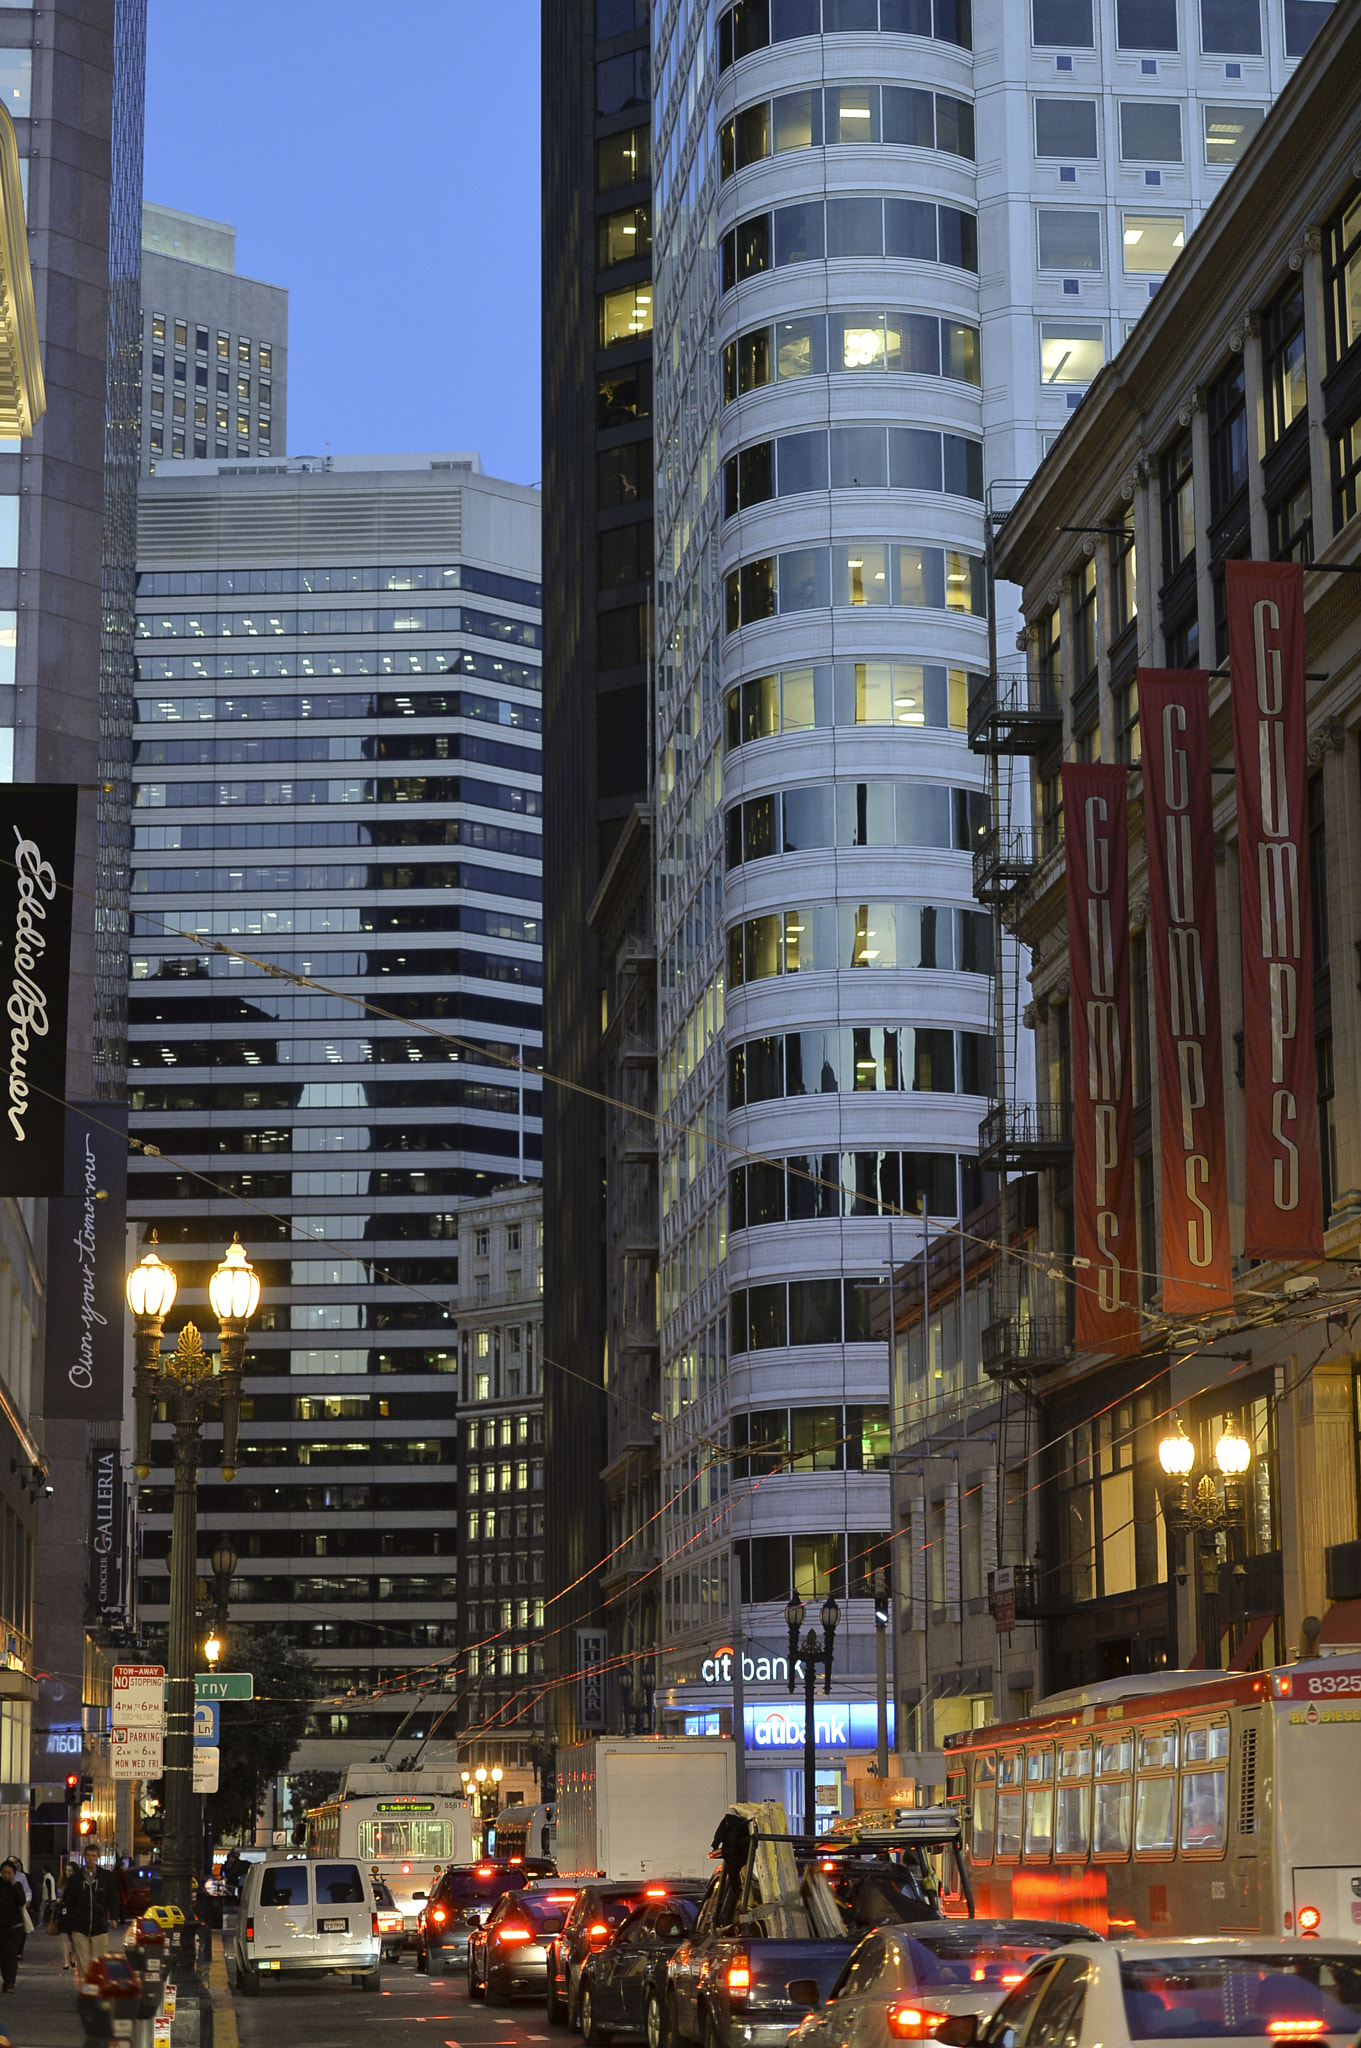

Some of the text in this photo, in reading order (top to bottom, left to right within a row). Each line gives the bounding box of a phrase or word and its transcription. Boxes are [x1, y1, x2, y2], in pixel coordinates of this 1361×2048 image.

[7, 824, 57, 1141] Eddie Bauer
[68, 1133, 107, 1389] Own your tomorrow
[93, 1452, 114, 1602] CROCKER GALLERIA
[118, 1667, 159, 1675] TOW-AWAY
[702, 1648, 806, 1682] citbank
[114, 1676, 162, 1688] NO STOPPING
[1308, 1675, 1361, 1694] 8325
[194, 1683, 228, 1697] arny
[129, 1732, 160, 1742] PARKING
[115, 1760, 159, 1768] MON WED FRI
[864, 1789, 910, 1801] 80 AST
